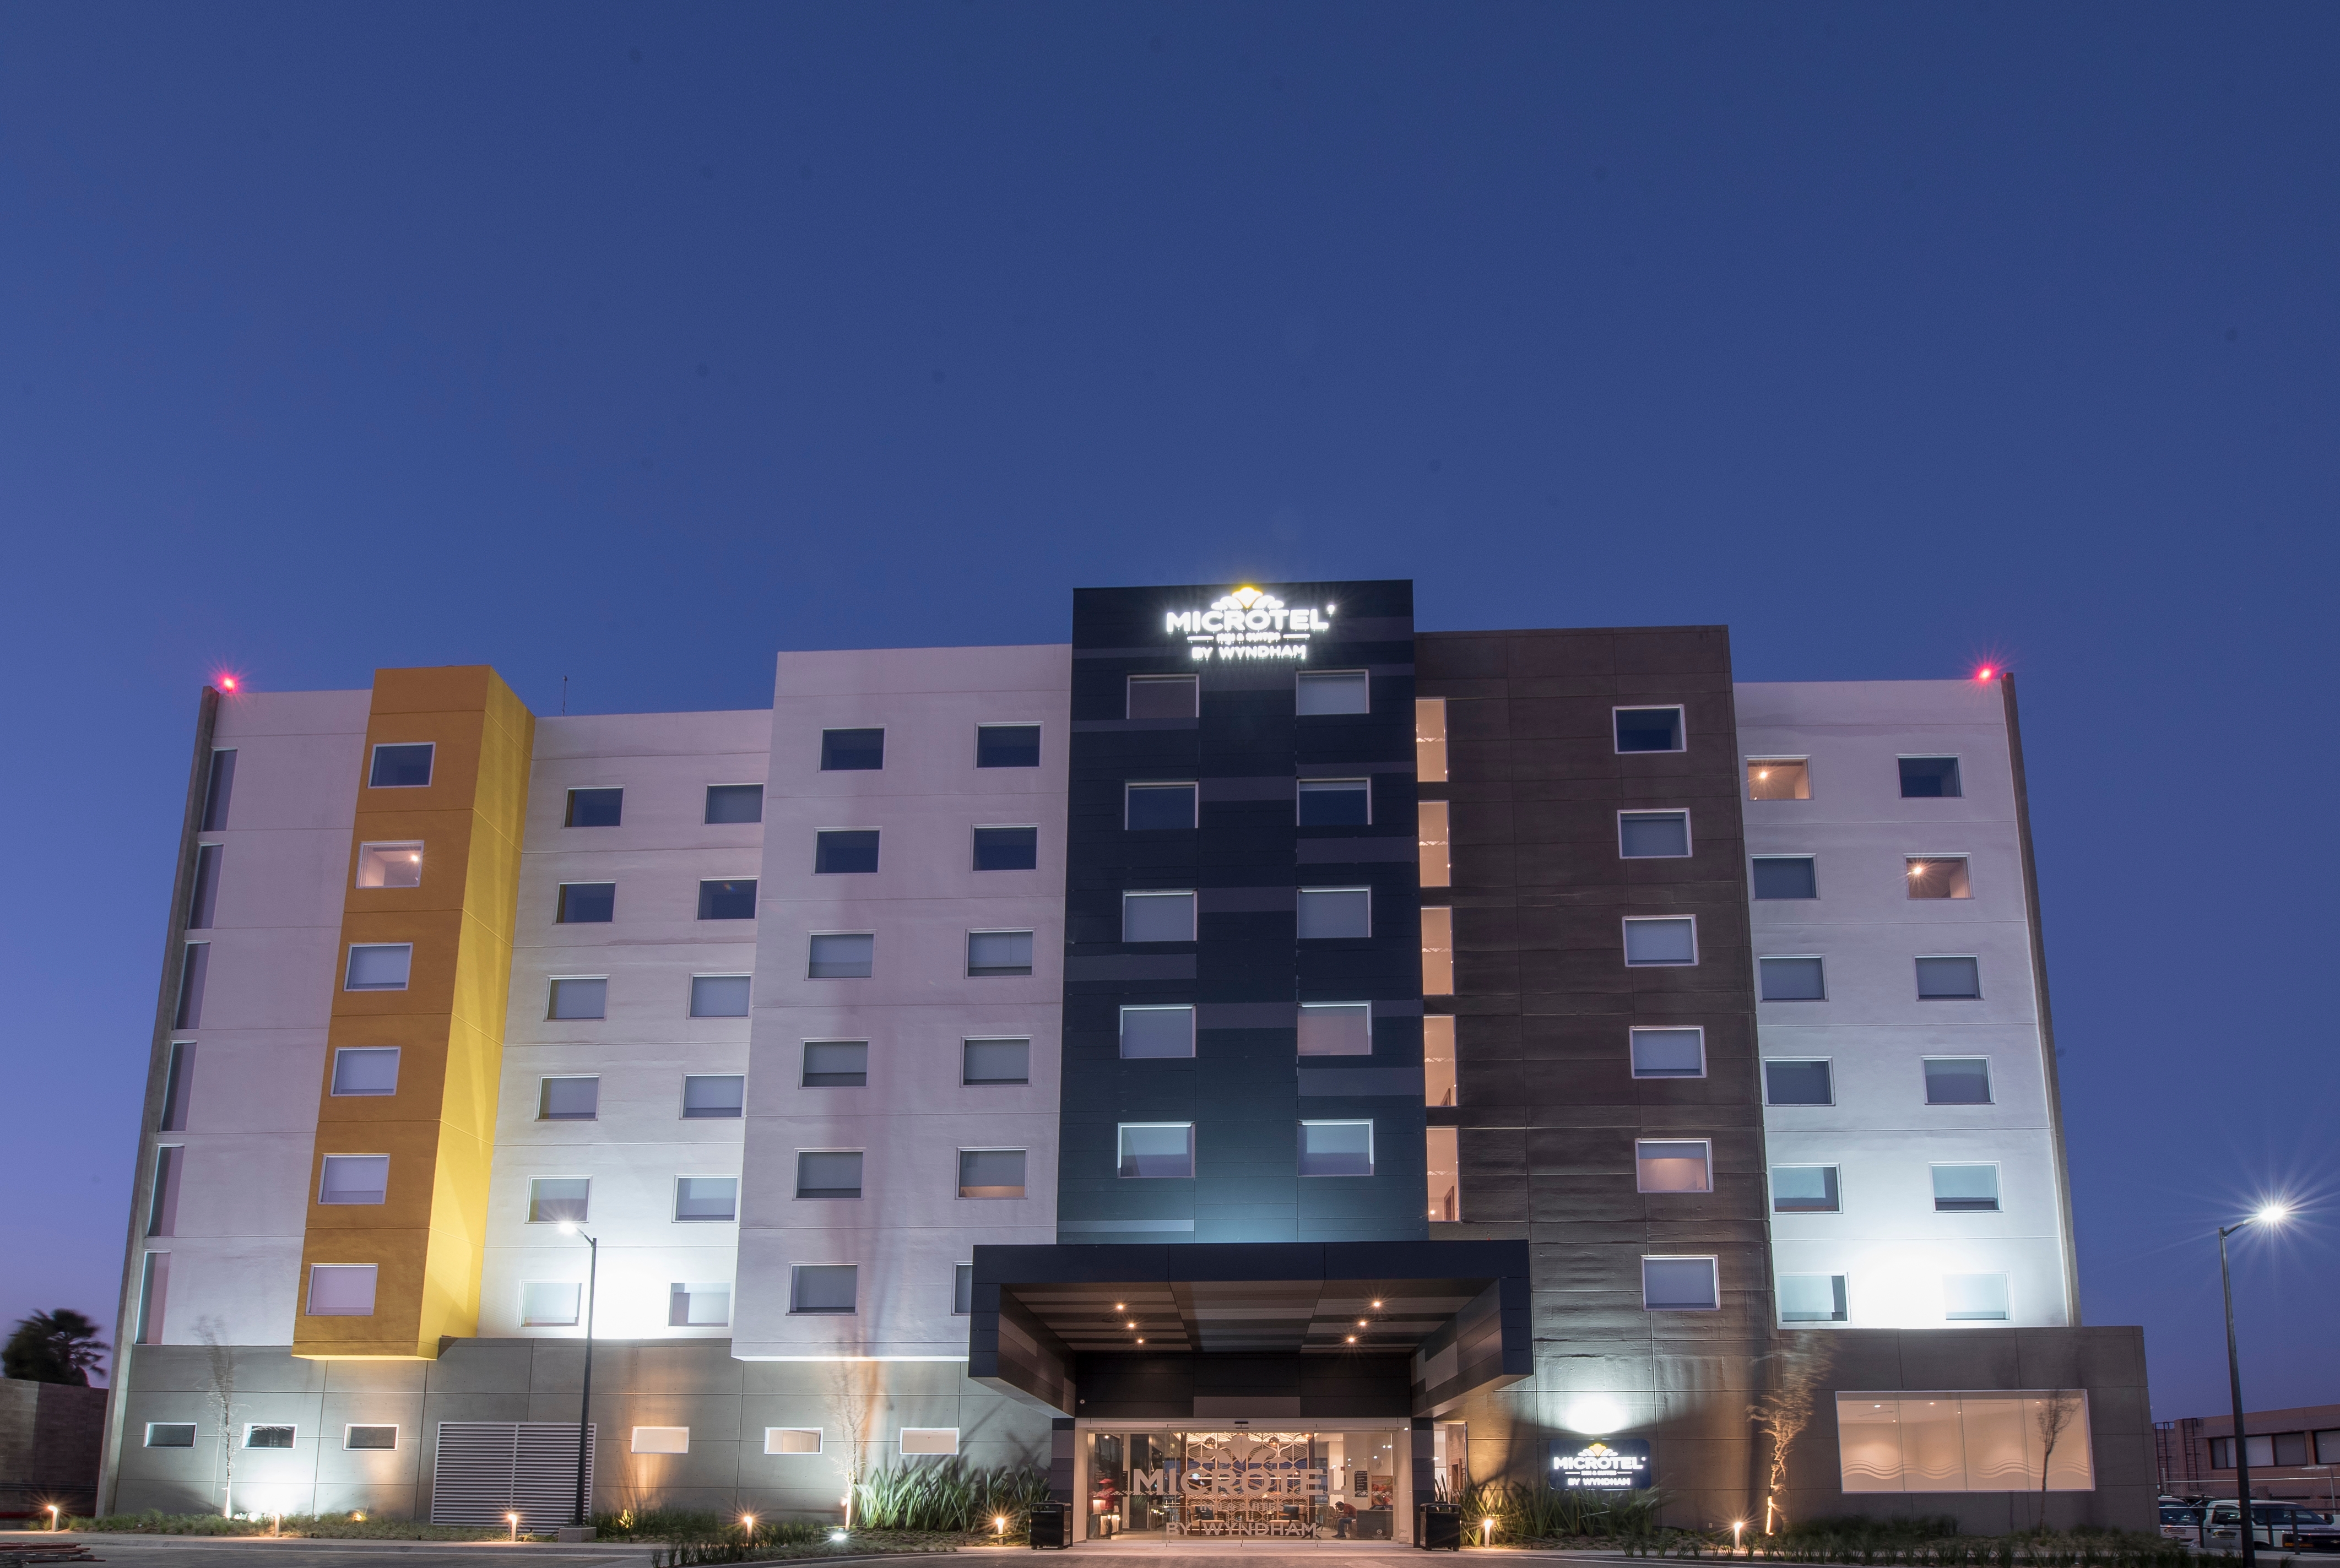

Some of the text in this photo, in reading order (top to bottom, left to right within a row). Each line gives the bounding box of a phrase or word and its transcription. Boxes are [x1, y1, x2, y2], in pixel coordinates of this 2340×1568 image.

[1167, 609, 1329, 632] MICROTEL
[1191, 645, 1306, 659] BY WYNDHAM
[1553, 1456, 1643, 1469] MICROTEL
[1134, 1468, 1349, 1496] MICROTEL
[1166, 1522, 1317, 1536] BY WYNDHAM
